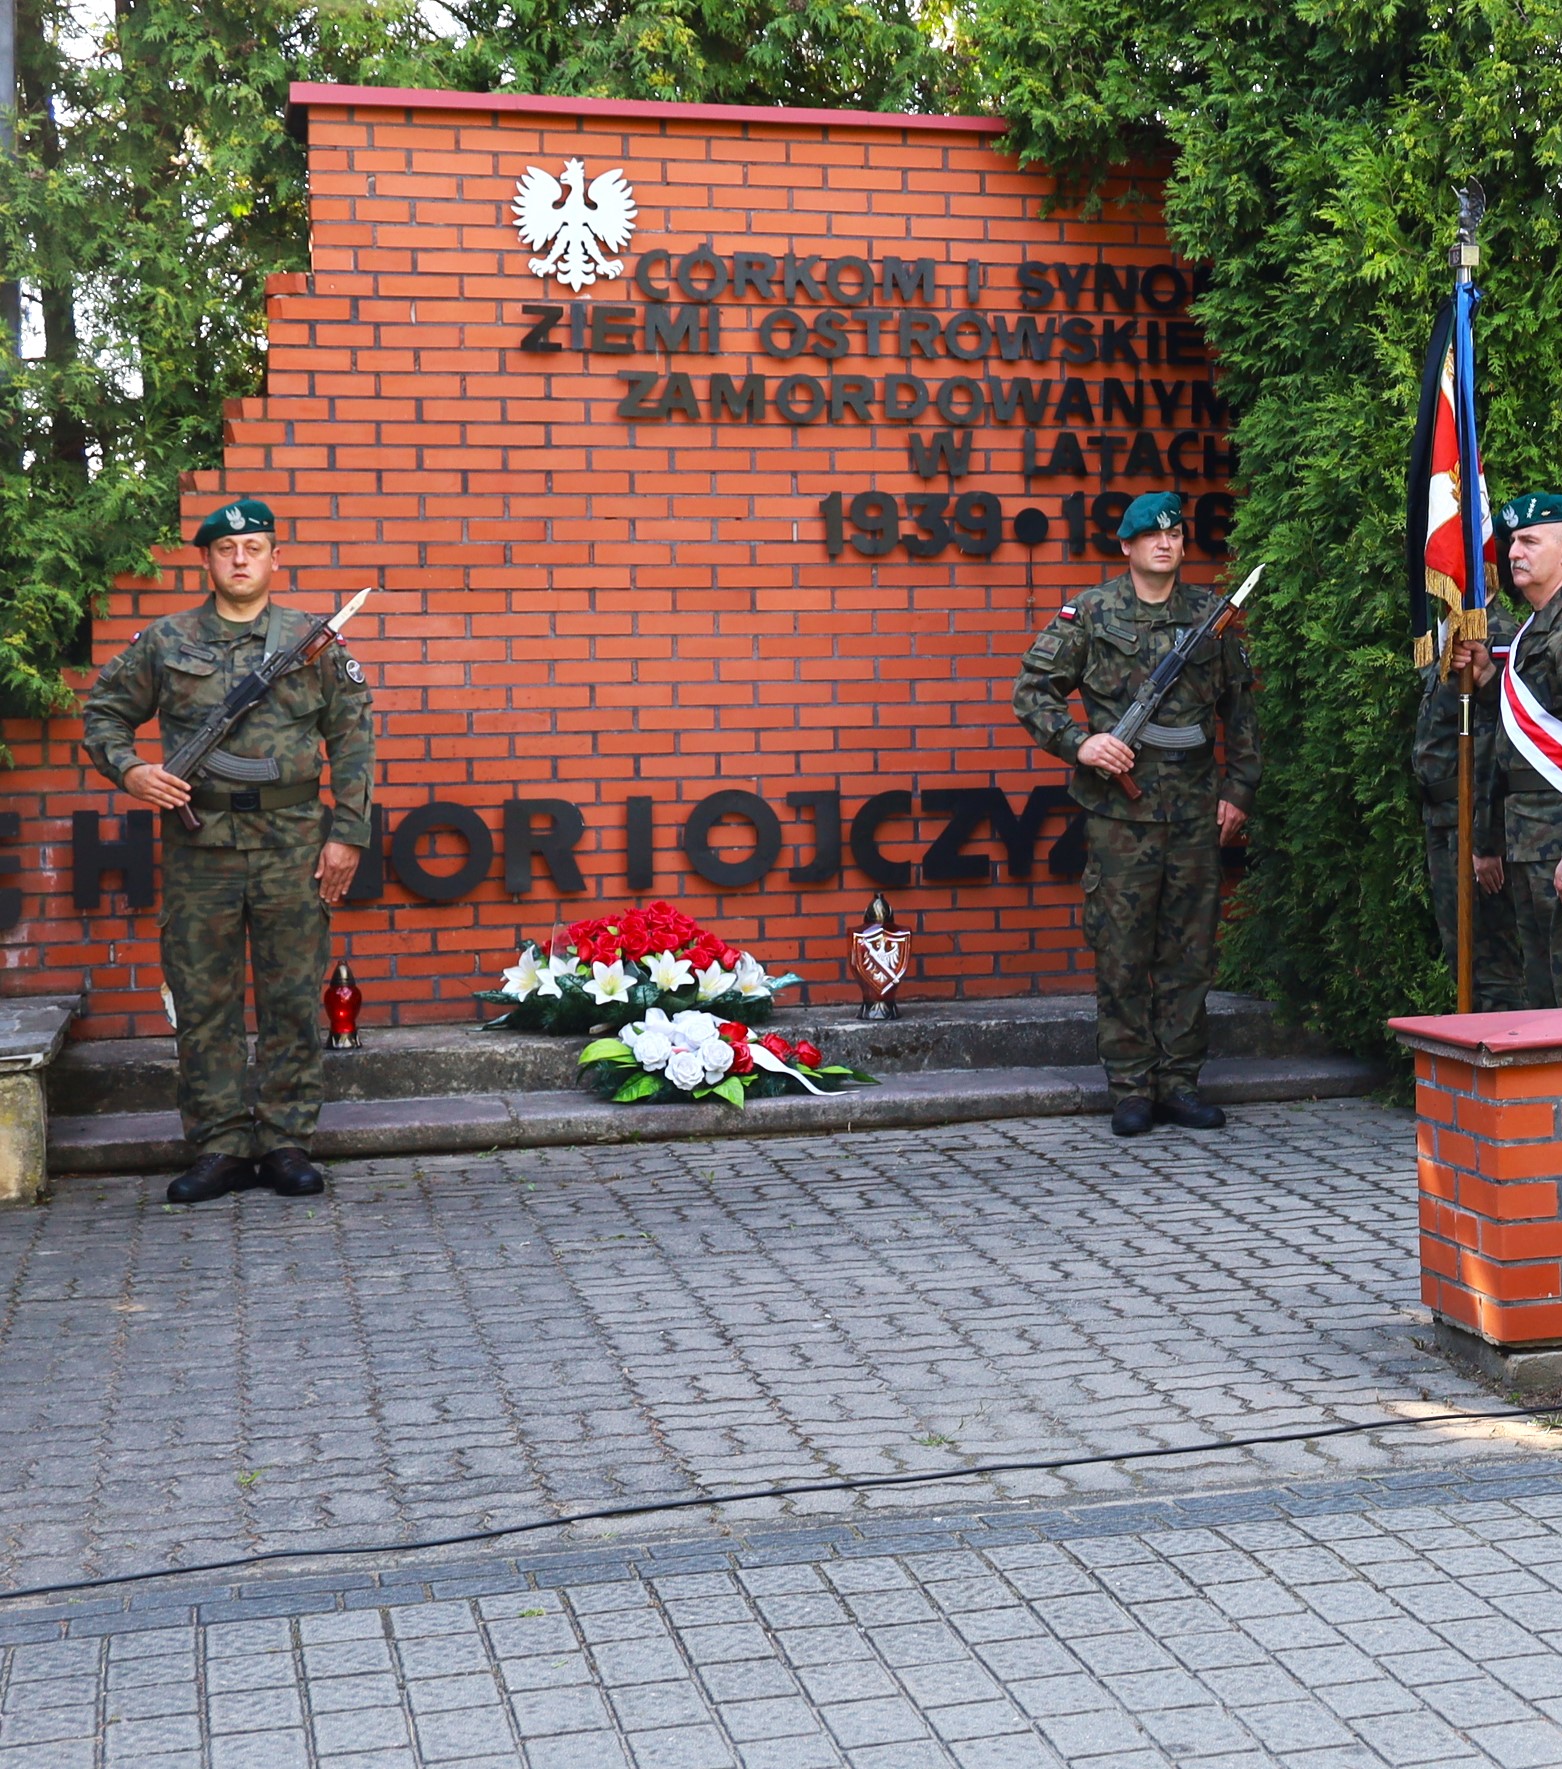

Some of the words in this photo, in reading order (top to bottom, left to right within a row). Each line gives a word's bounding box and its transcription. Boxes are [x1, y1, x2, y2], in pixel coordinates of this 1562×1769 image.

[636, 243, 935, 305] CÓRKOM
[966, 258, 980, 304] I
[520, 302, 720, 355] ZIEMI
[908, 430, 973, 479] W
[1024, 429, 1240, 481] LATACH
[626, 796, 652, 889] I
